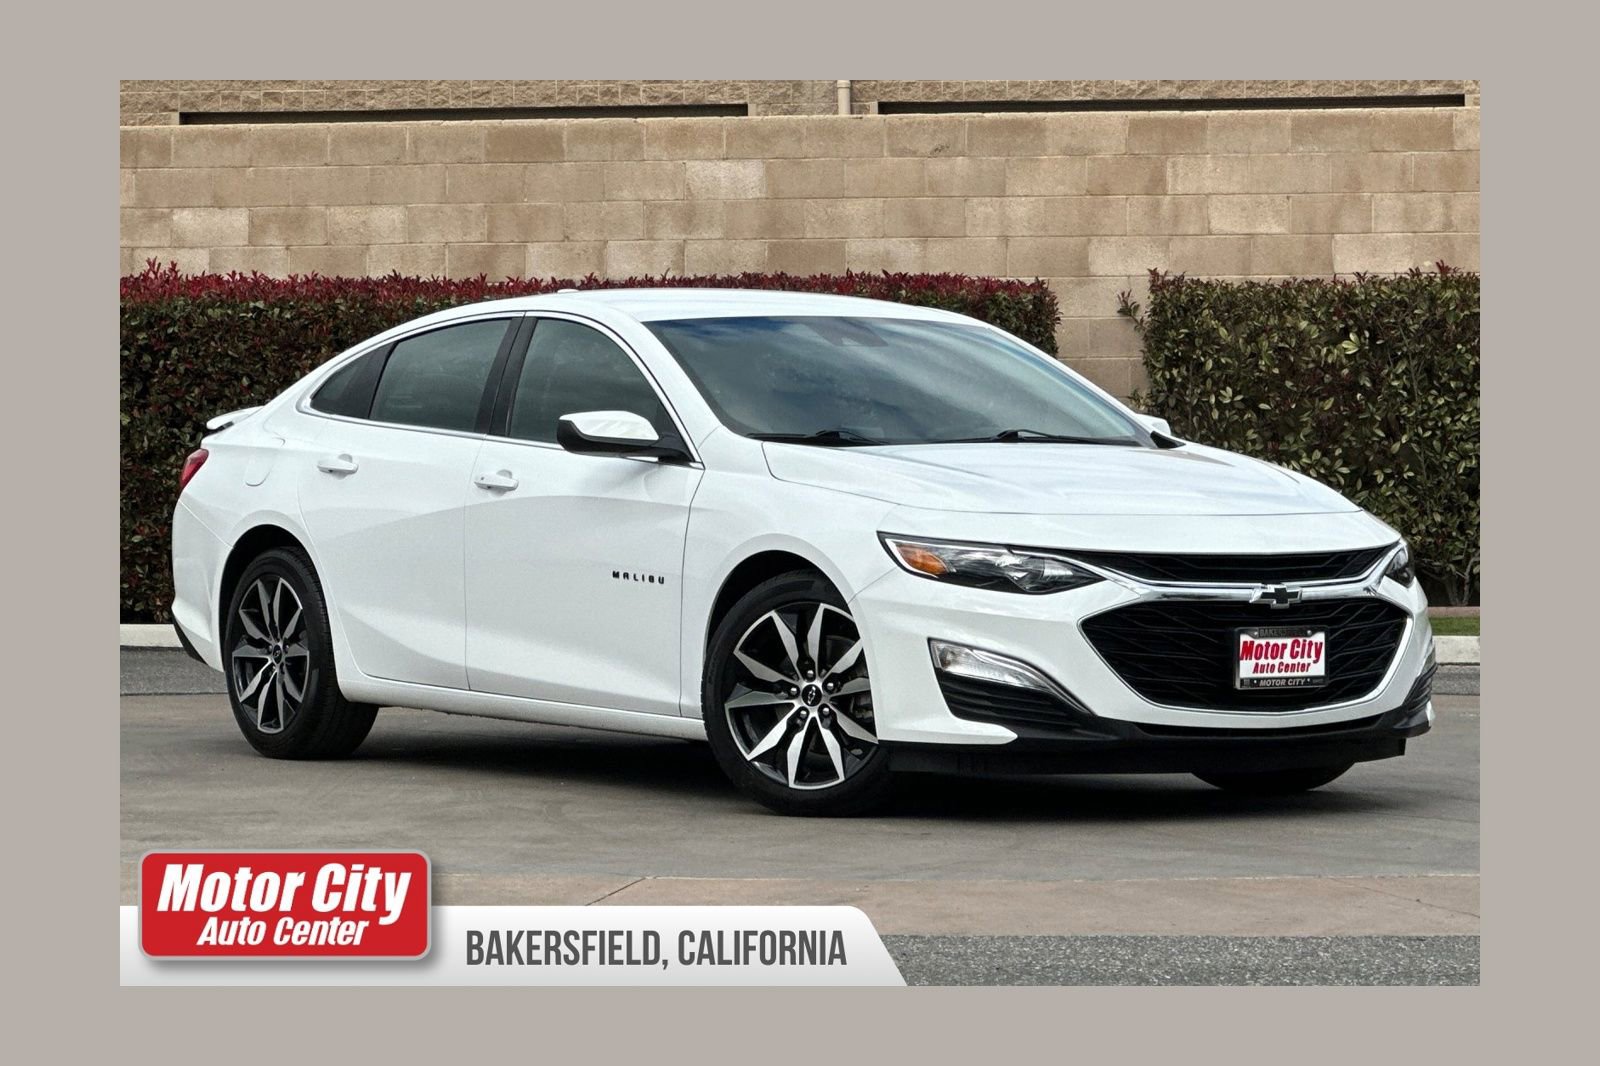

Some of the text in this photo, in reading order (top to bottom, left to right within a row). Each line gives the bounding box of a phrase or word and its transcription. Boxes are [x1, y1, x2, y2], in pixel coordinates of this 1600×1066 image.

[612, 570, 665, 585] MALIBU
[1239, 638, 1323, 664] Motor City
[1252, 661, 1311, 674] Auto Center
[1259, 678, 1287, 687] MOTOR
[1287, 678, 1306, 686] CITY
